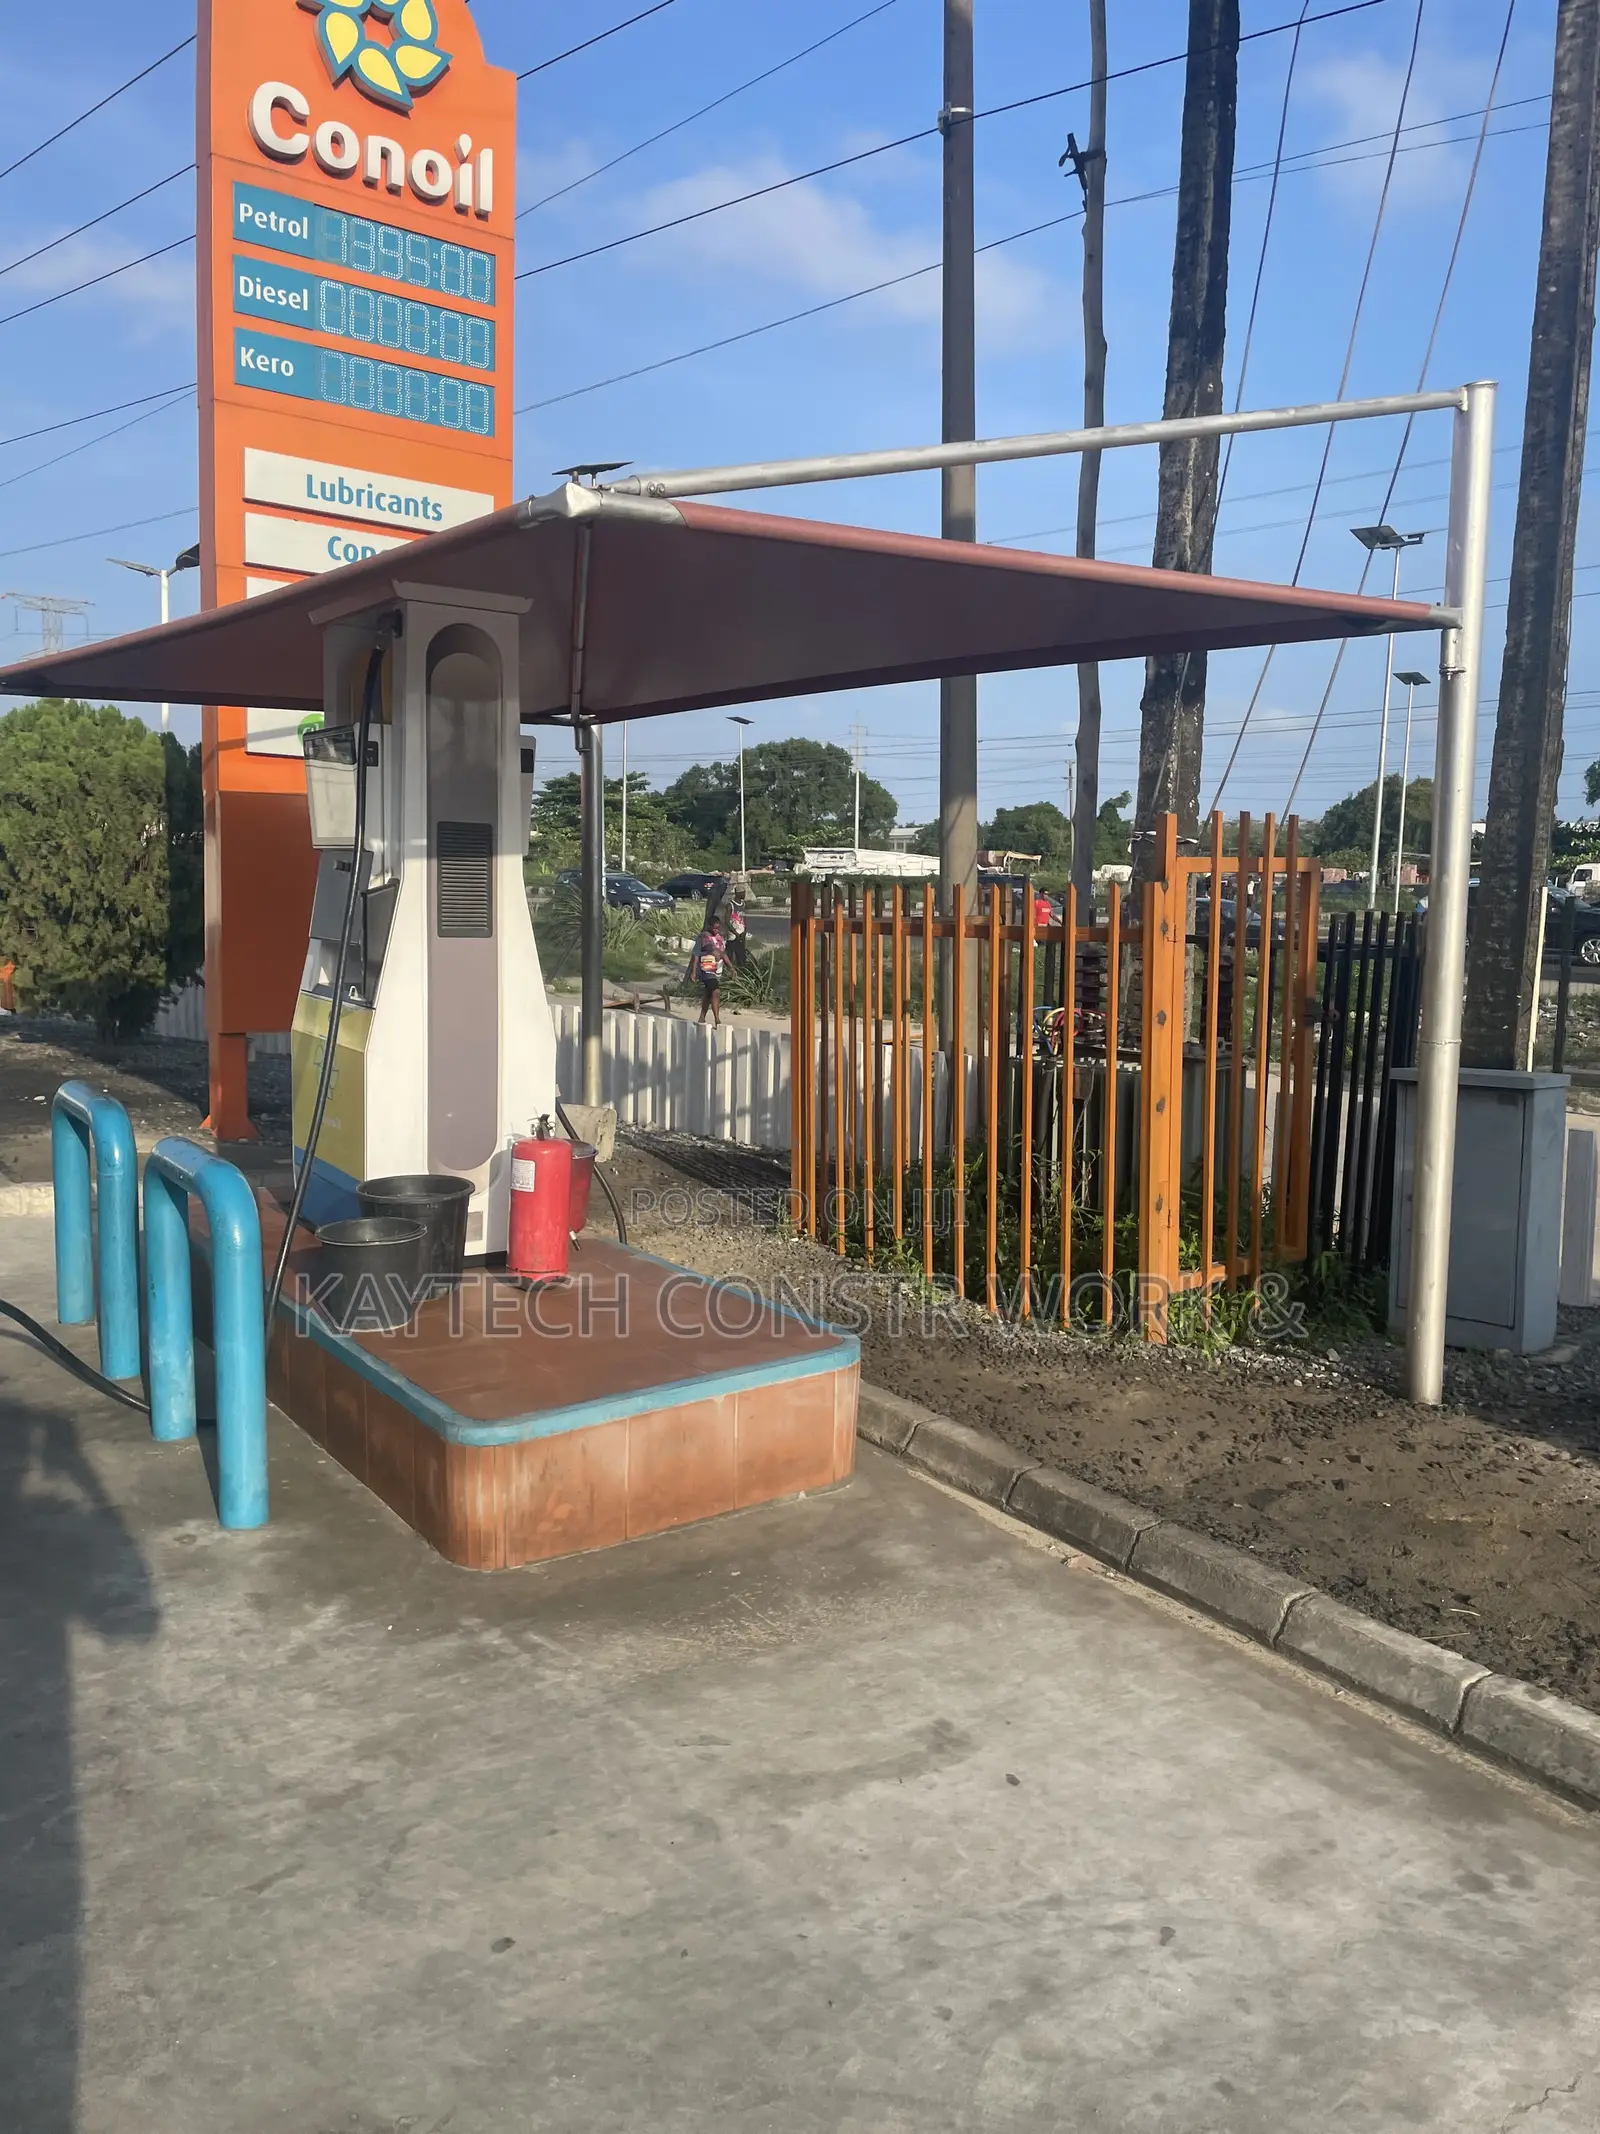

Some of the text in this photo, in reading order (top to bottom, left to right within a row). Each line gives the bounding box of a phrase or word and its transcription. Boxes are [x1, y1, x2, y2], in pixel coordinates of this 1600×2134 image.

[249, 81, 494, 219] Conoil
[239, 203, 308, 240] Petrol
[239, 276, 308, 311] Diesel
[240, 346, 294, 377] Kero
[306, 474, 443, 521] Lubricants
